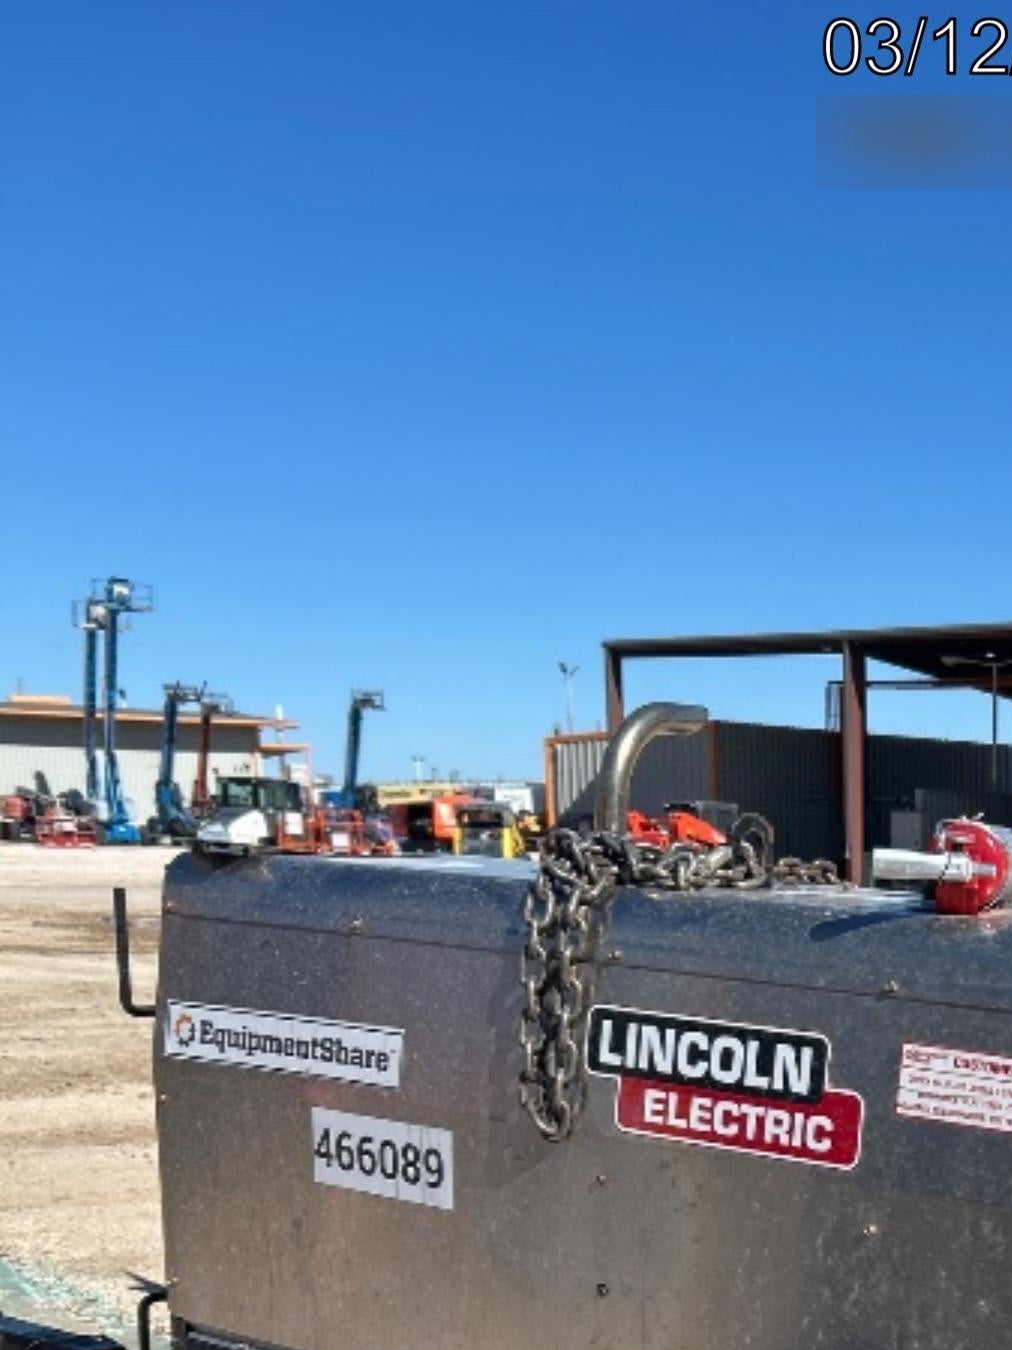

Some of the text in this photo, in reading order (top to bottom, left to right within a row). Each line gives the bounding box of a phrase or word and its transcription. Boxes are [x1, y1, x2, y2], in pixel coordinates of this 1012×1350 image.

[199, 1019, 391, 1072] EquipmentShare
[598, 1019, 814, 1096] LINCOLN
[643, 1089, 835, 1153] ELECTRIC
[314, 1127, 445, 1189] 466089
